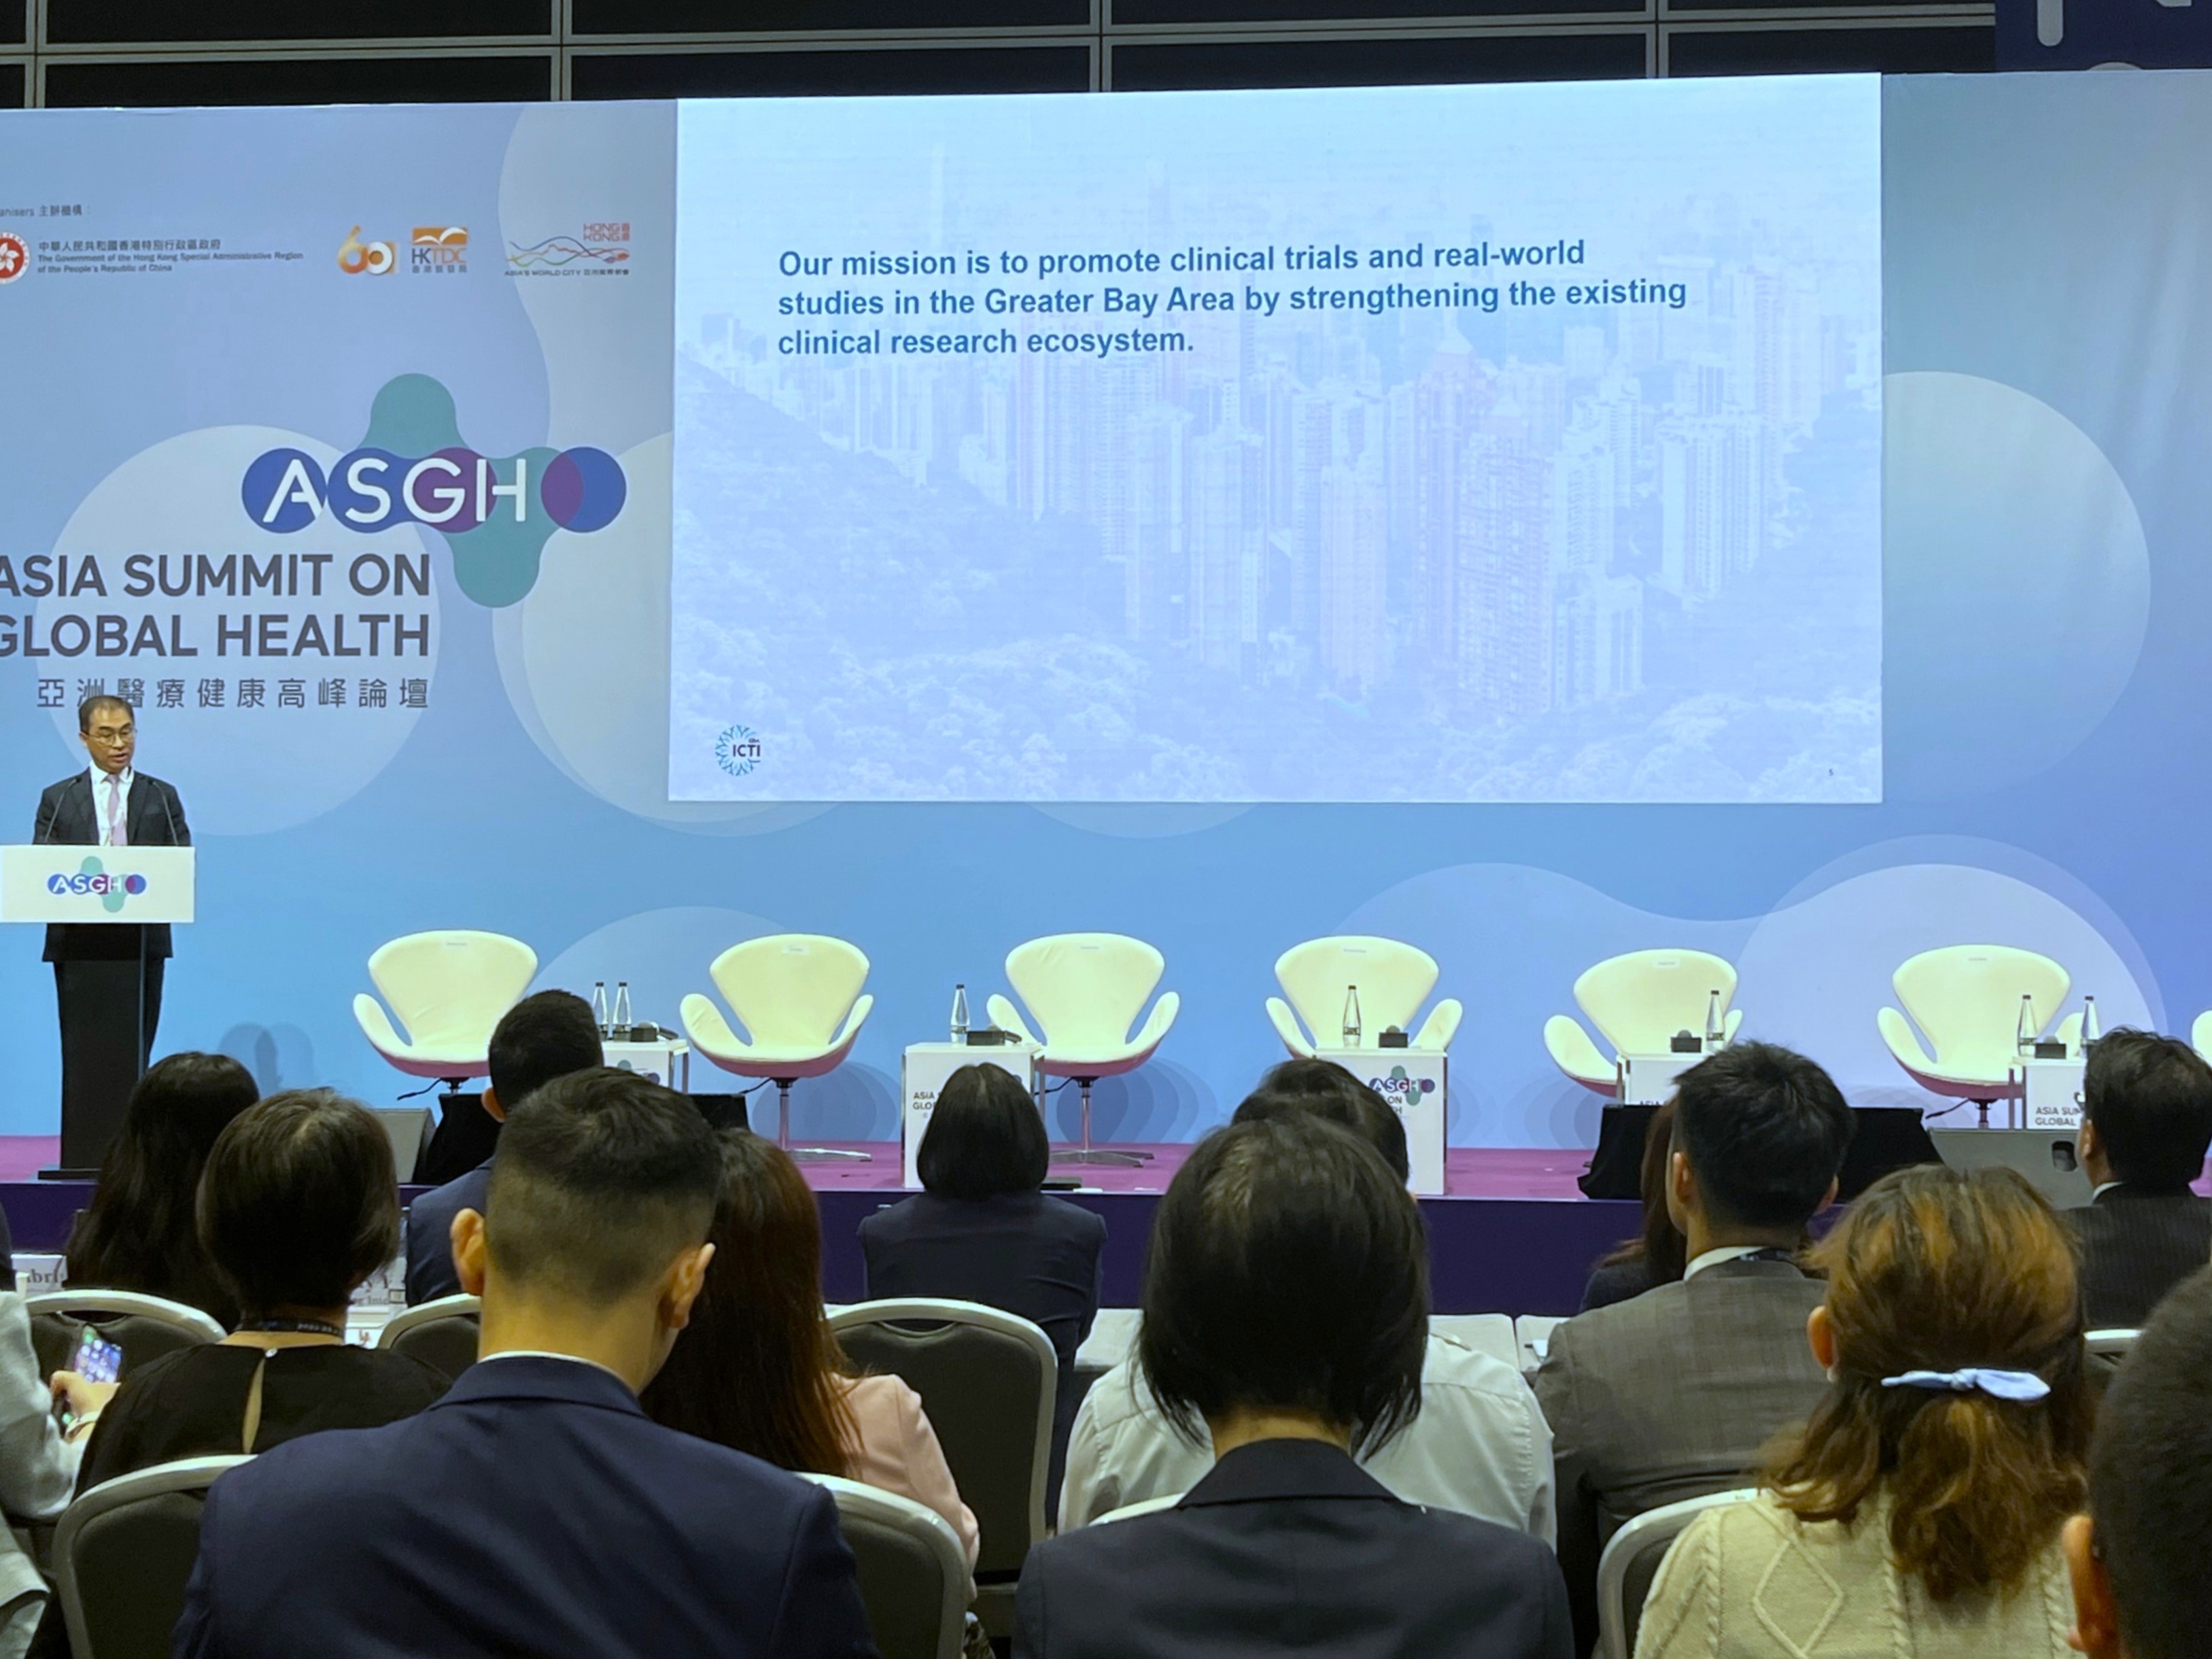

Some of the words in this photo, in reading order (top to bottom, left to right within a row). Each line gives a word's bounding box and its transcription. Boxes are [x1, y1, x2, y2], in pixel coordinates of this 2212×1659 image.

[583, 222, 620, 232] HONG
[583, 233, 620, 242] KONG
[38, 254, 52, 262] The
[55, 254, 105, 262] Government
[157, 253, 177, 262] Kong
[180, 252, 210, 261] Special
[275, 252, 303, 261] Region
[411, 247, 467, 264] HKTDC
[779, 251, 833, 276] Our
[842, 250, 956, 275] mission
[967, 250, 990, 275] is
[1000, 250, 1028, 274] to
[1039, 248, 1160, 280] promote
[1171, 245, 1274, 272] clinical
[1285, 243, 1358, 270] trials
[1368, 242, 1423, 269] and
[1434, 239, 1585, 268] real-world
[149, 264, 172, 272] China
[778, 290, 884, 315] studies
[895, 290, 919, 315] in
[929, 288, 975, 314] the
[985, 288, 1094, 314] Greater
[1104, 287, 1158, 318] Bay
[1167, 286, 1234, 312] Area
[1245, 285, 1280, 317] by
[1290, 281, 1498, 315] strengthening
[1509, 280, 1556, 306] the
[1566, 277, 1686, 309] existing
[778, 328, 880, 355] clinical
[891, 328, 1016, 354] research
[1027, 328, 1194, 359] ecosystem.
[262, 458, 526, 524] ASGH
[0, 554, 107, 597] ASIA
[123, 553, 332, 597] SUMMIT
[349, 553, 430, 597] ON
[217, 614, 429, 657] HEALTH
[733, 745, 761, 757] ICTI
[52, 875, 122, 893] ASGH
[1373, 1079, 1419, 1093] ASGH
[914, 1091, 935, 1099] ASIA
[1387, 1095, 1402, 1104] ON
[2036, 1106, 2058, 1115] ASIA
[2035, 1117, 2076, 1126] GLOBAL
